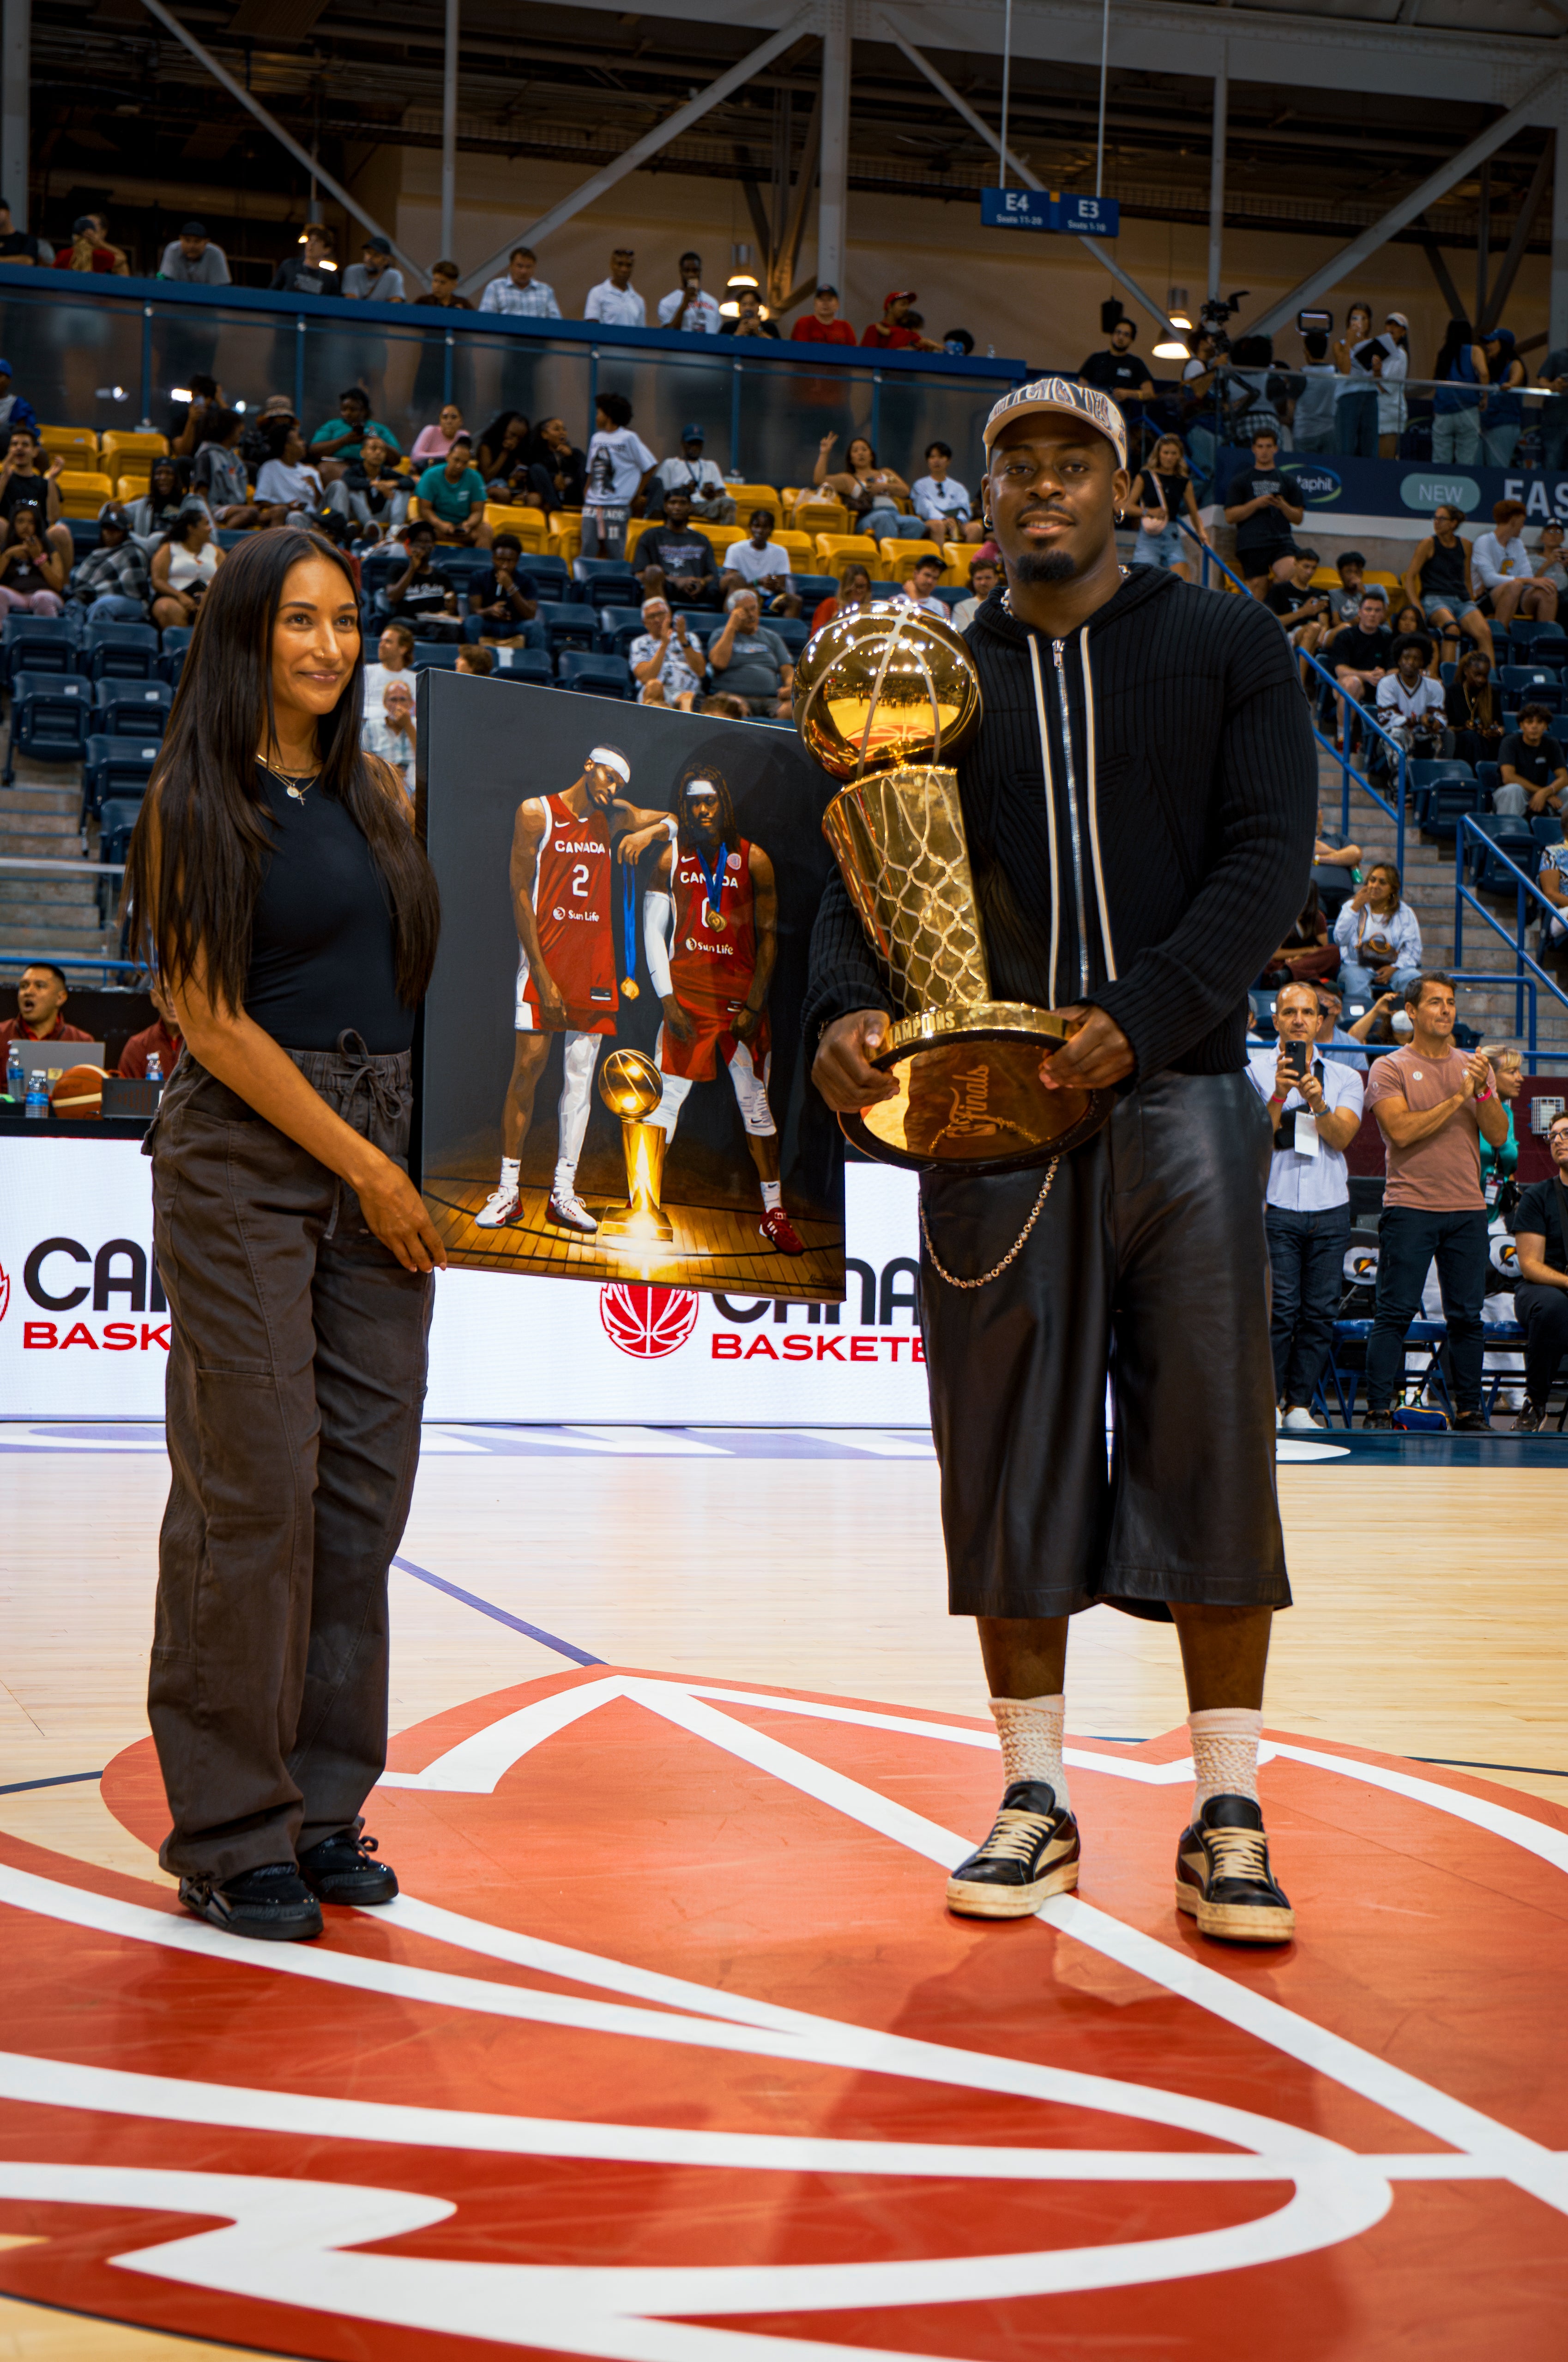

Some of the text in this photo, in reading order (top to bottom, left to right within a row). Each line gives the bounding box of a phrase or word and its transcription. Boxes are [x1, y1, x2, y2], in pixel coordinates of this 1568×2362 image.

[1005, 193, 1029, 212] E4
[1078, 199, 1100, 219] E3
[996, 214, 1019, 224] Seats
[1067, 219, 1088, 230] Seats
[1419, 484, 1463, 503] NEW
[555, 840, 605, 854] CANADA
[572, 864, 589, 897] 2
[568, 909, 600, 922] Sun Life
[697, 941, 734, 955] Sun Life
[949, 1064, 1003, 1130] Finals
[23, 1321, 172, 1351] BASK
